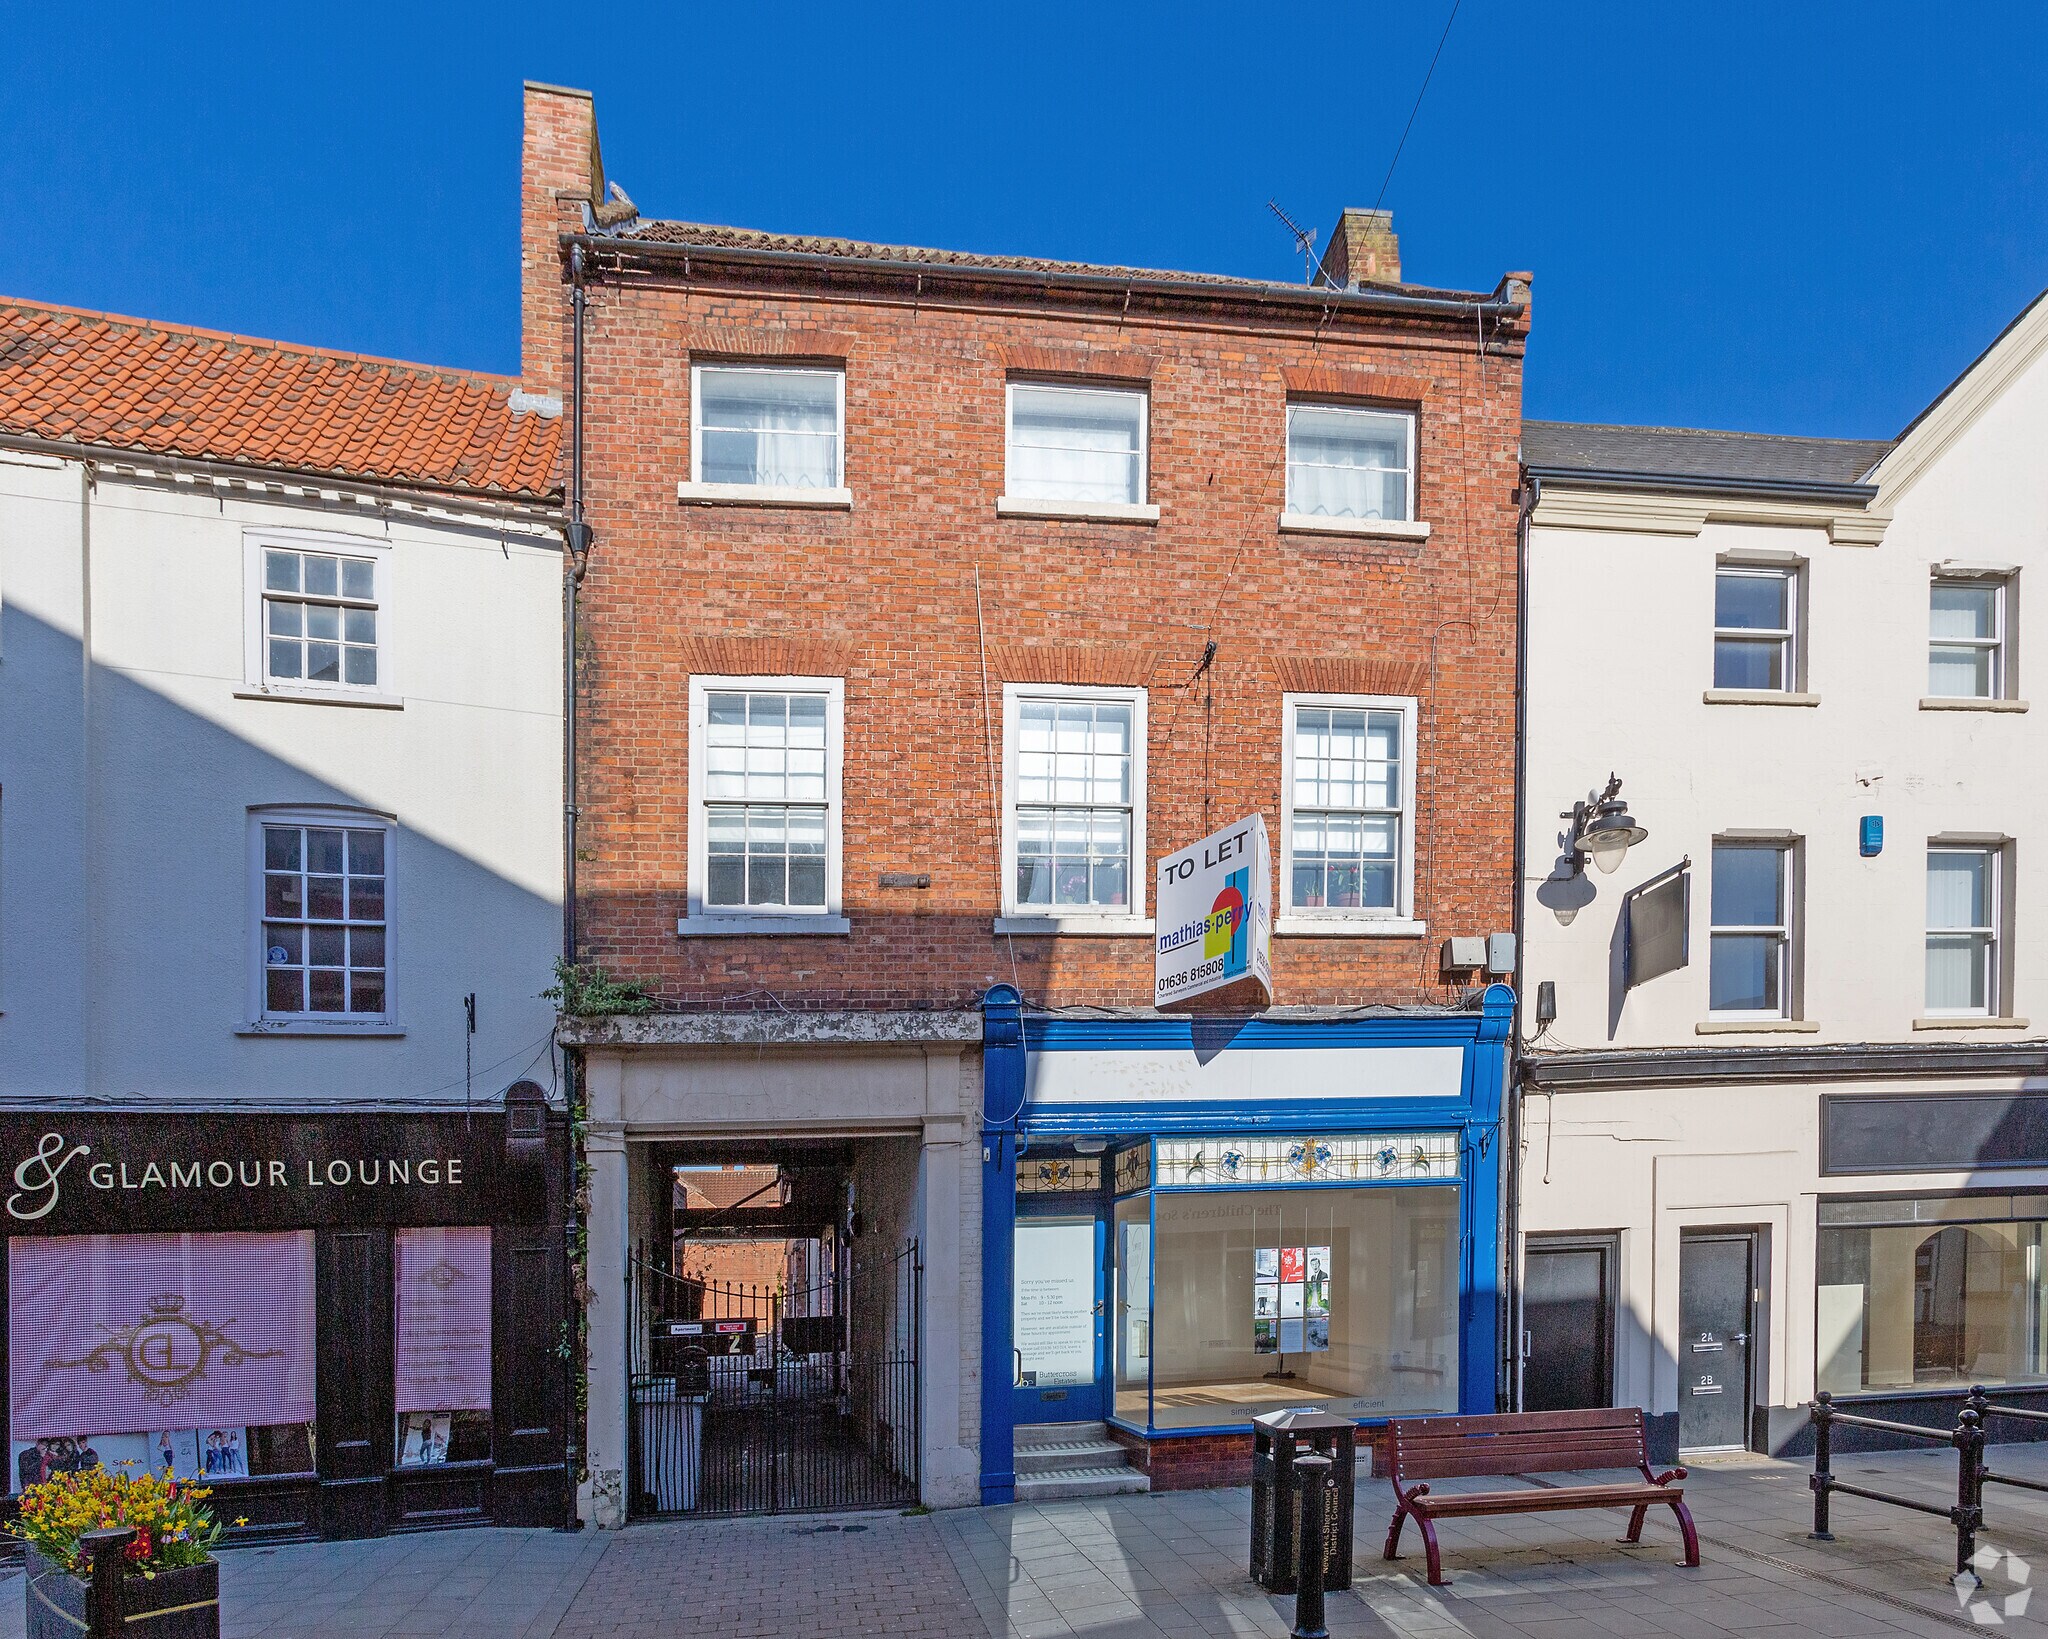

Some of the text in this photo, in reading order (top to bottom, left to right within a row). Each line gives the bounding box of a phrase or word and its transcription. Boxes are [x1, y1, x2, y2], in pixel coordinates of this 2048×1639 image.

[1164, 858, 1195, 885] TO
[1204, 830, 1249, 869] LET
[1158, 958, 1224, 991] 01636 815808
[90, 1161, 289, 1189] GLAMOUR
[307, 1158, 464, 1186] LOUNGE
[728, 1333, 741, 1354] 2
[1701, 1332, 1714, 1342] 2A
[1039, 1370, 1078, 1379] Buttercross
[1700, 1375, 1713, 1385] 2B
[1230, 1406, 1258, 1416] simple
[1353, 1399, 1385, 1409] efficient
[1322, 1489, 1332, 1534] Sherwood
[1330, 1487, 1339, 1555] District Council
[1322, 1541, 1330, 1574] Newark
